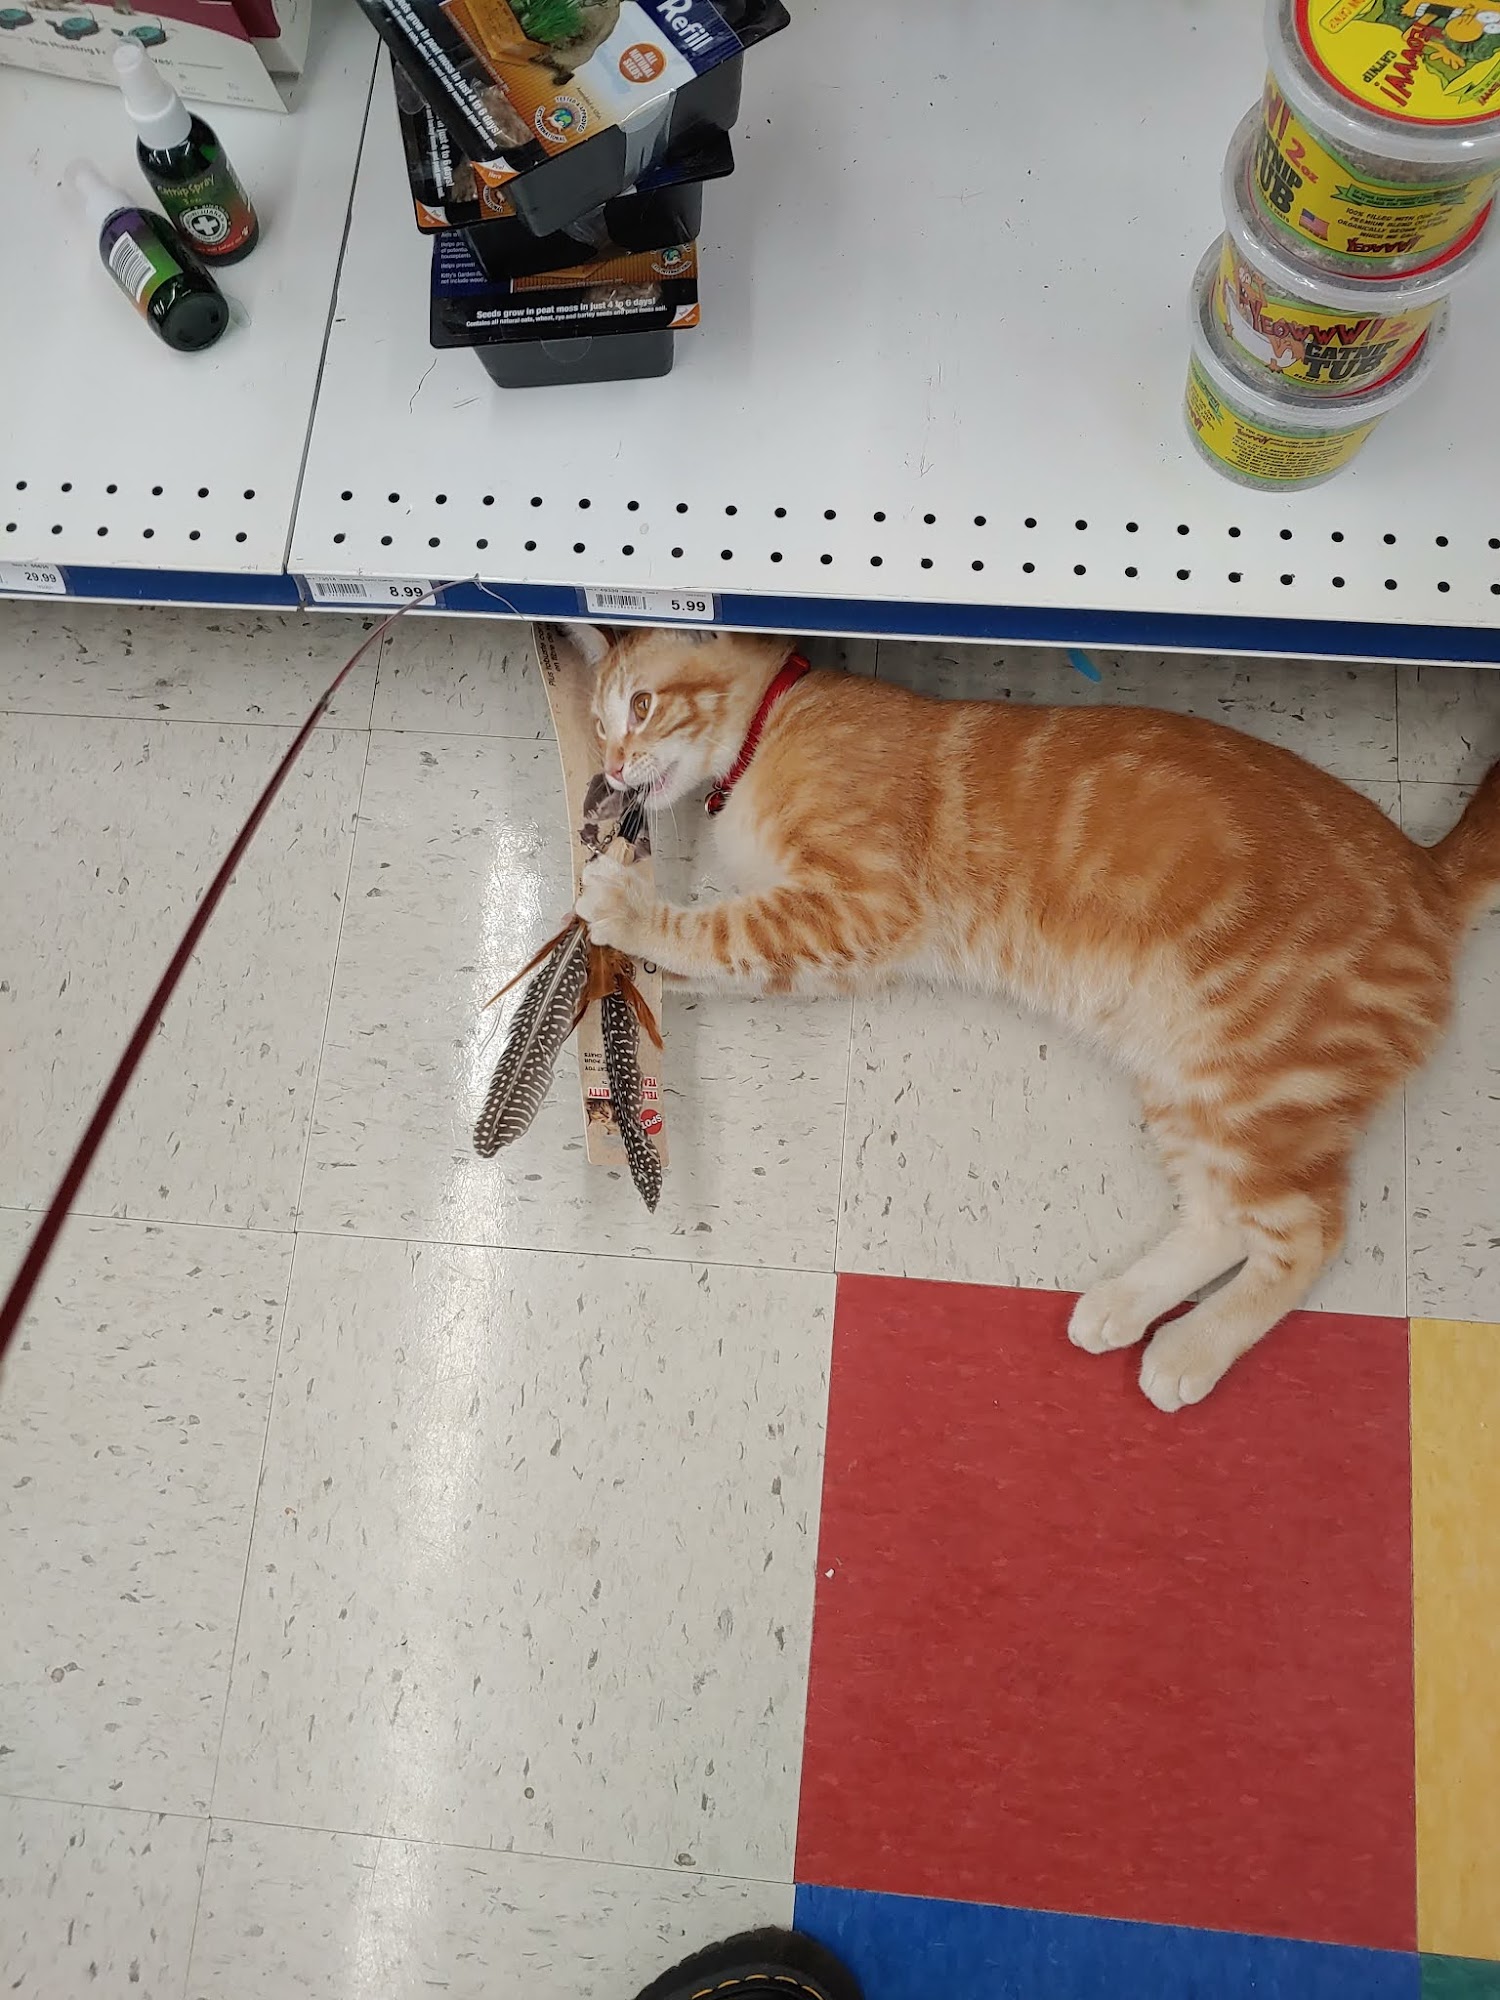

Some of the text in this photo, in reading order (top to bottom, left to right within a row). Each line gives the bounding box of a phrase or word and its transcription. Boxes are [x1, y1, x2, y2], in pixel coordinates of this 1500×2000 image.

[406, 11, 425, 31] grow
[656, 0, 714, 51] Refill
[438, 54, 456, 74] moss
[629, 48, 655, 78] NATURAL
[644, 52, 658, 65] ALL
[1362, 50, 1397, 83] CATNIP
[1376, 22, 1445, 108] YEOWWW!
[454, 79, 472, 96] just
[472, 99, 481, 110] to
[478, 108, 488, 116] 6
[482, 114, 502, 136] days!
[1286, 138, 1318, 184] 2 oz
[1346, 208, 1364, 216] 100%
[1366, 213, 1392, 221] FILLED
[1350, 217, 1384, 227] PREMIUM
[1338, 219, 1386, 233] ORGANICALLY
[476, 310, 502, 319] Seeds
[504, 309, 524, 318] grow
[526, 307, 534, 315] in
[536, 305, 554, 316] peat
[580, 303, 588, 311] in
[590, 302, 606, 312] just
[634, 297, 656, 308] days!
[466, 320, 490, 328] Contains
[1250, 300, 1386, 346] YEOWWW!
[1304, 338, 1400, 358] CATNIP
[1303, 352, 1388, 380] TUB
[24, 572, 56, 582] 29.99
[389, 586, 424, 597] 8.99
[671, 600, 706, 612] 5.99
[540, 642, 552, 670] robuste
[550, 644, 558, 660] fibre
[554, 662, 560, 672] en
[548, 672, 556, 686] Plus
[589, 1088, 610, 1098] KITTY
[641, 1114, 662, 1129] SPOT
